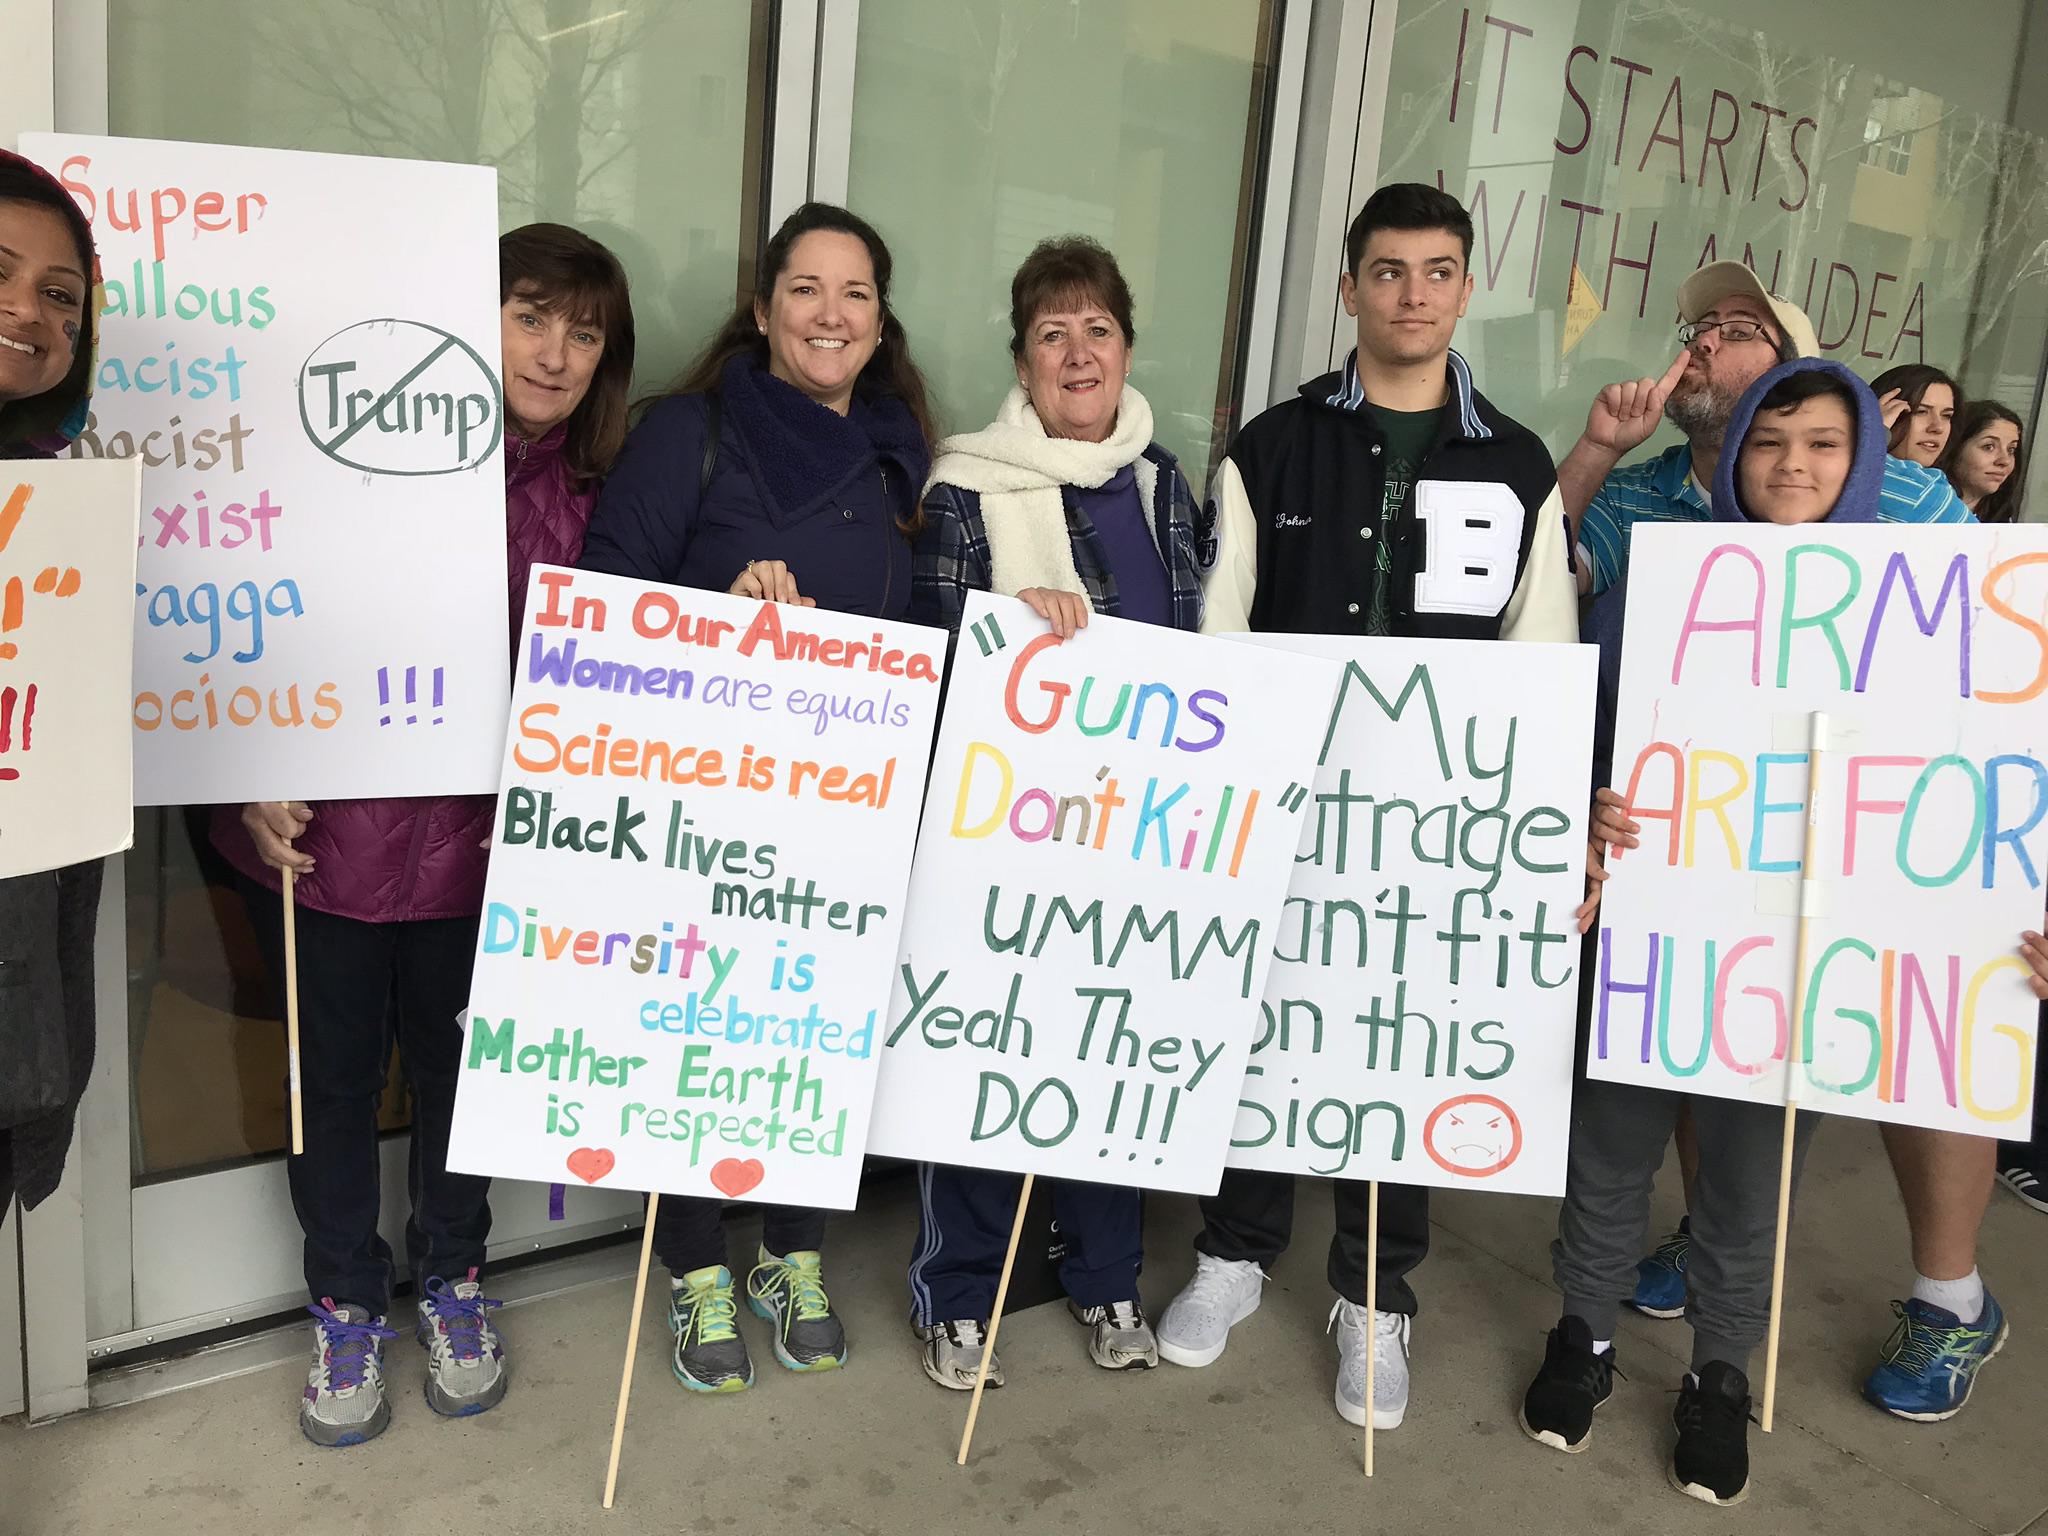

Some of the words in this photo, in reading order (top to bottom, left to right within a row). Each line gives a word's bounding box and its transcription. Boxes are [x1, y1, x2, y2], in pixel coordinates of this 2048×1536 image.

[1449, 8, 1533, 134] IT
[1554, 45, 1818, 212] STARTS
[59, 155, 268, 263] Super
[101, 257, 276, 331] allous
[1437, 169, 1658, 318] WITH
[1804, 257, 1924, 364] IDEA
[99, 341, 247, 402] acist
[308, 360, 491, 464] Trump
[1413, 479, 1526, 617] B
[536, 571, 607, 632] In
[632, 590, 735, 648] Our
[737, 601, 939, 684] America
[1671, 543, 2048, 705] ARMS
[134, 672, 343, 731] ocious
[528, 633, 694, 700] Women
[702, 674, 772, 711] are
[786, 688, 910, 736] equals
[1317, 659, 1517, 815] My
[513, 703, 728, 788] Science
[736, 744, 777, 791] is
[788, 757, 897, 811] real
[949, 741, 1126, 850] Don't
[502, 786, 648, 863] Black
[664, 799, 778, 880] lives
[1612, 741, 1810, 873] ARE
[1842, 754, 2048, 889] FOR
[483, 902, 740, 1006] Diversity
[770, 940, 816, 993] is
[711, 877, 887, 937] matter
[1273, 885, 1427, 975] an't
[1436, 888, 1573, 988] fit
[467, 1016, 648, 1089] Mother
[676, 1044, 823, 1122] Earth
[639, 991, 877, 1060] celebrated
[885, 962, 1033, 1058] Yeah
[1075, 987, 1225, 1092] They
[1354, 980, 1515, 1080] this
[1596, 927, 2034, 1123] HUGGING
[546, 1092, 585, 1138] is
[620, 1100, 848, 1168] respected
[970, 1071, 1079, 1148] DO
[1230, 1066, 1406, 1174] Sign
